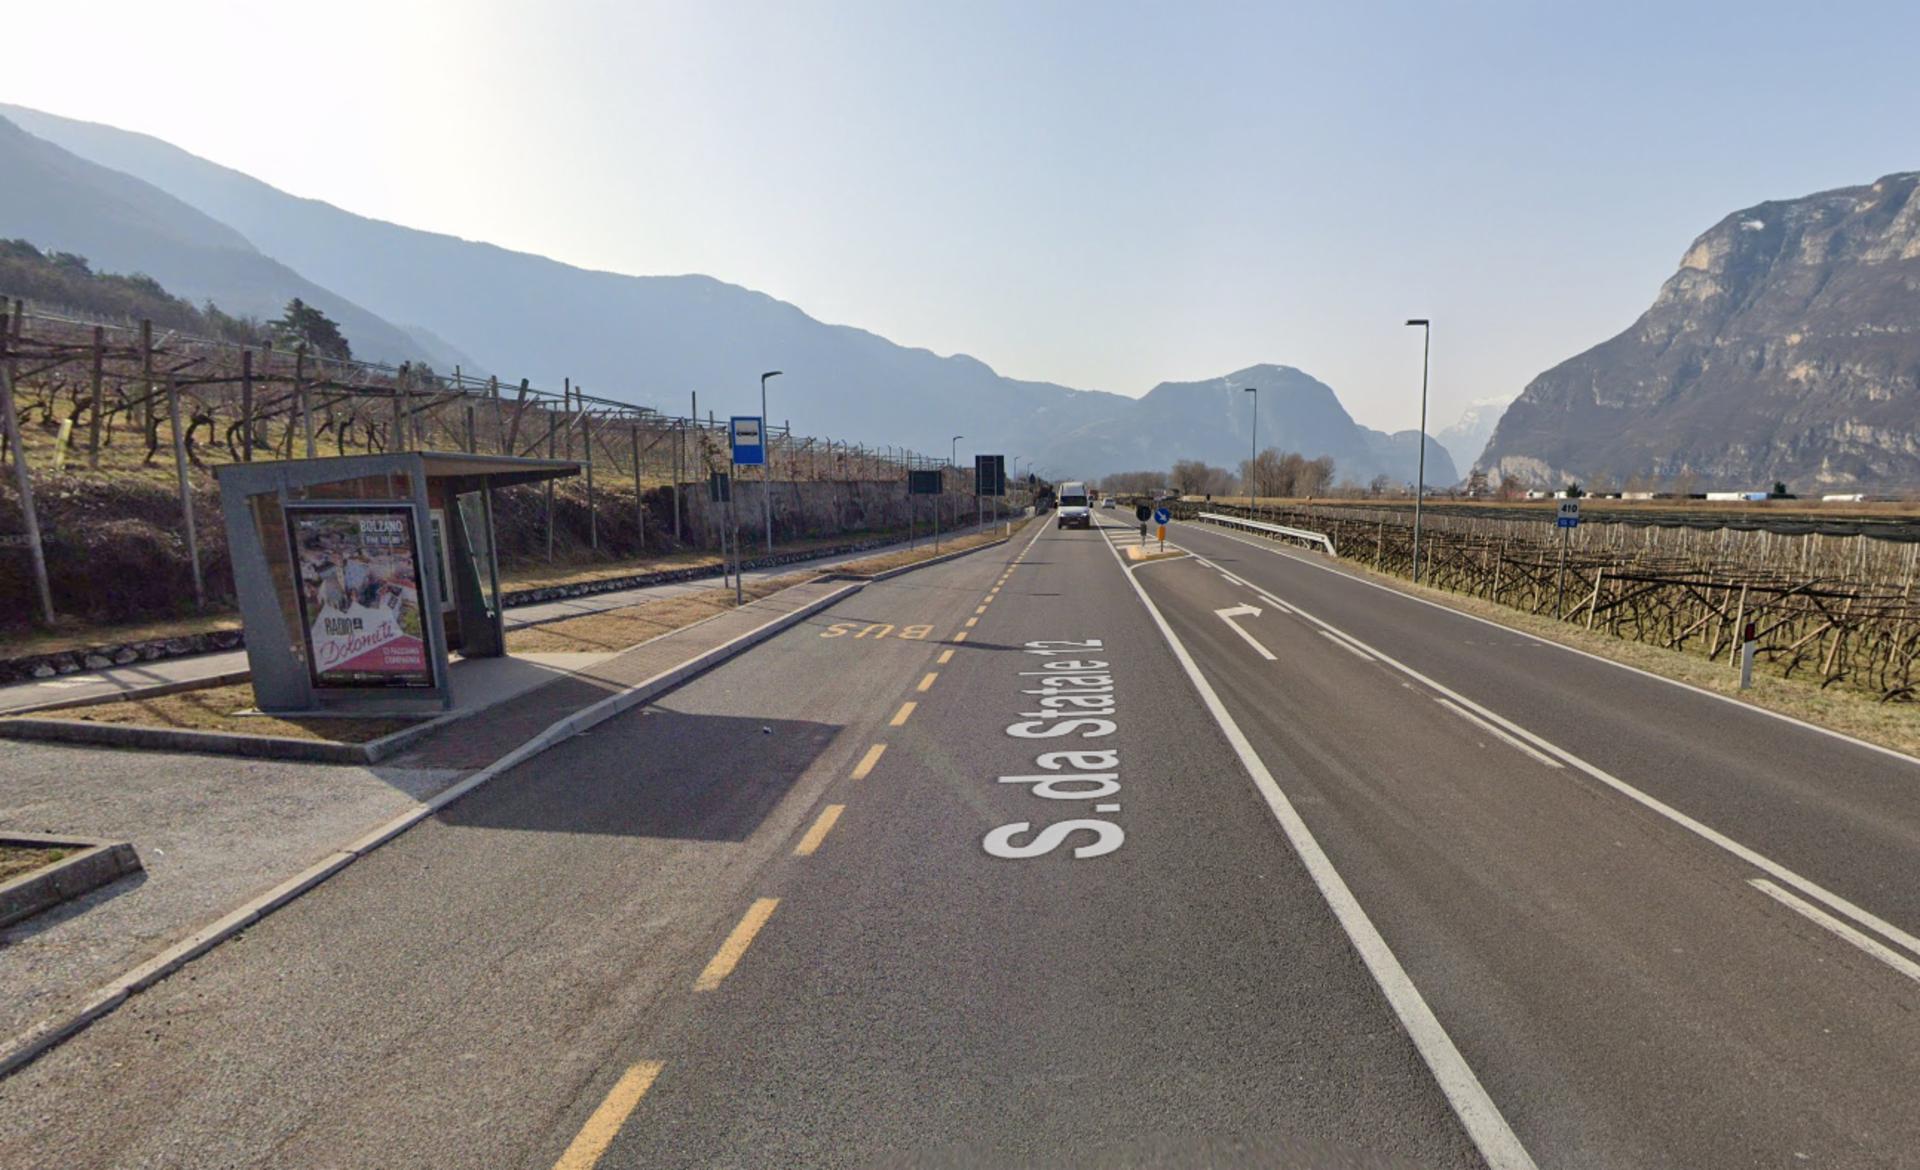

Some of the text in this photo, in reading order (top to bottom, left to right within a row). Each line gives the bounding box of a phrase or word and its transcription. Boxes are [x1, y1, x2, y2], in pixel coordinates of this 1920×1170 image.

[1561, 503, 1578, 513] 410
[360, 519, 403, 532] BOLZANO
[324, 617, 353, 636] RADIO
[820, 623, 935, 640] BUS
[320, 621, 393, 665] Dolomiti
[983, 639, 1125, 858] S.da Statale 12
